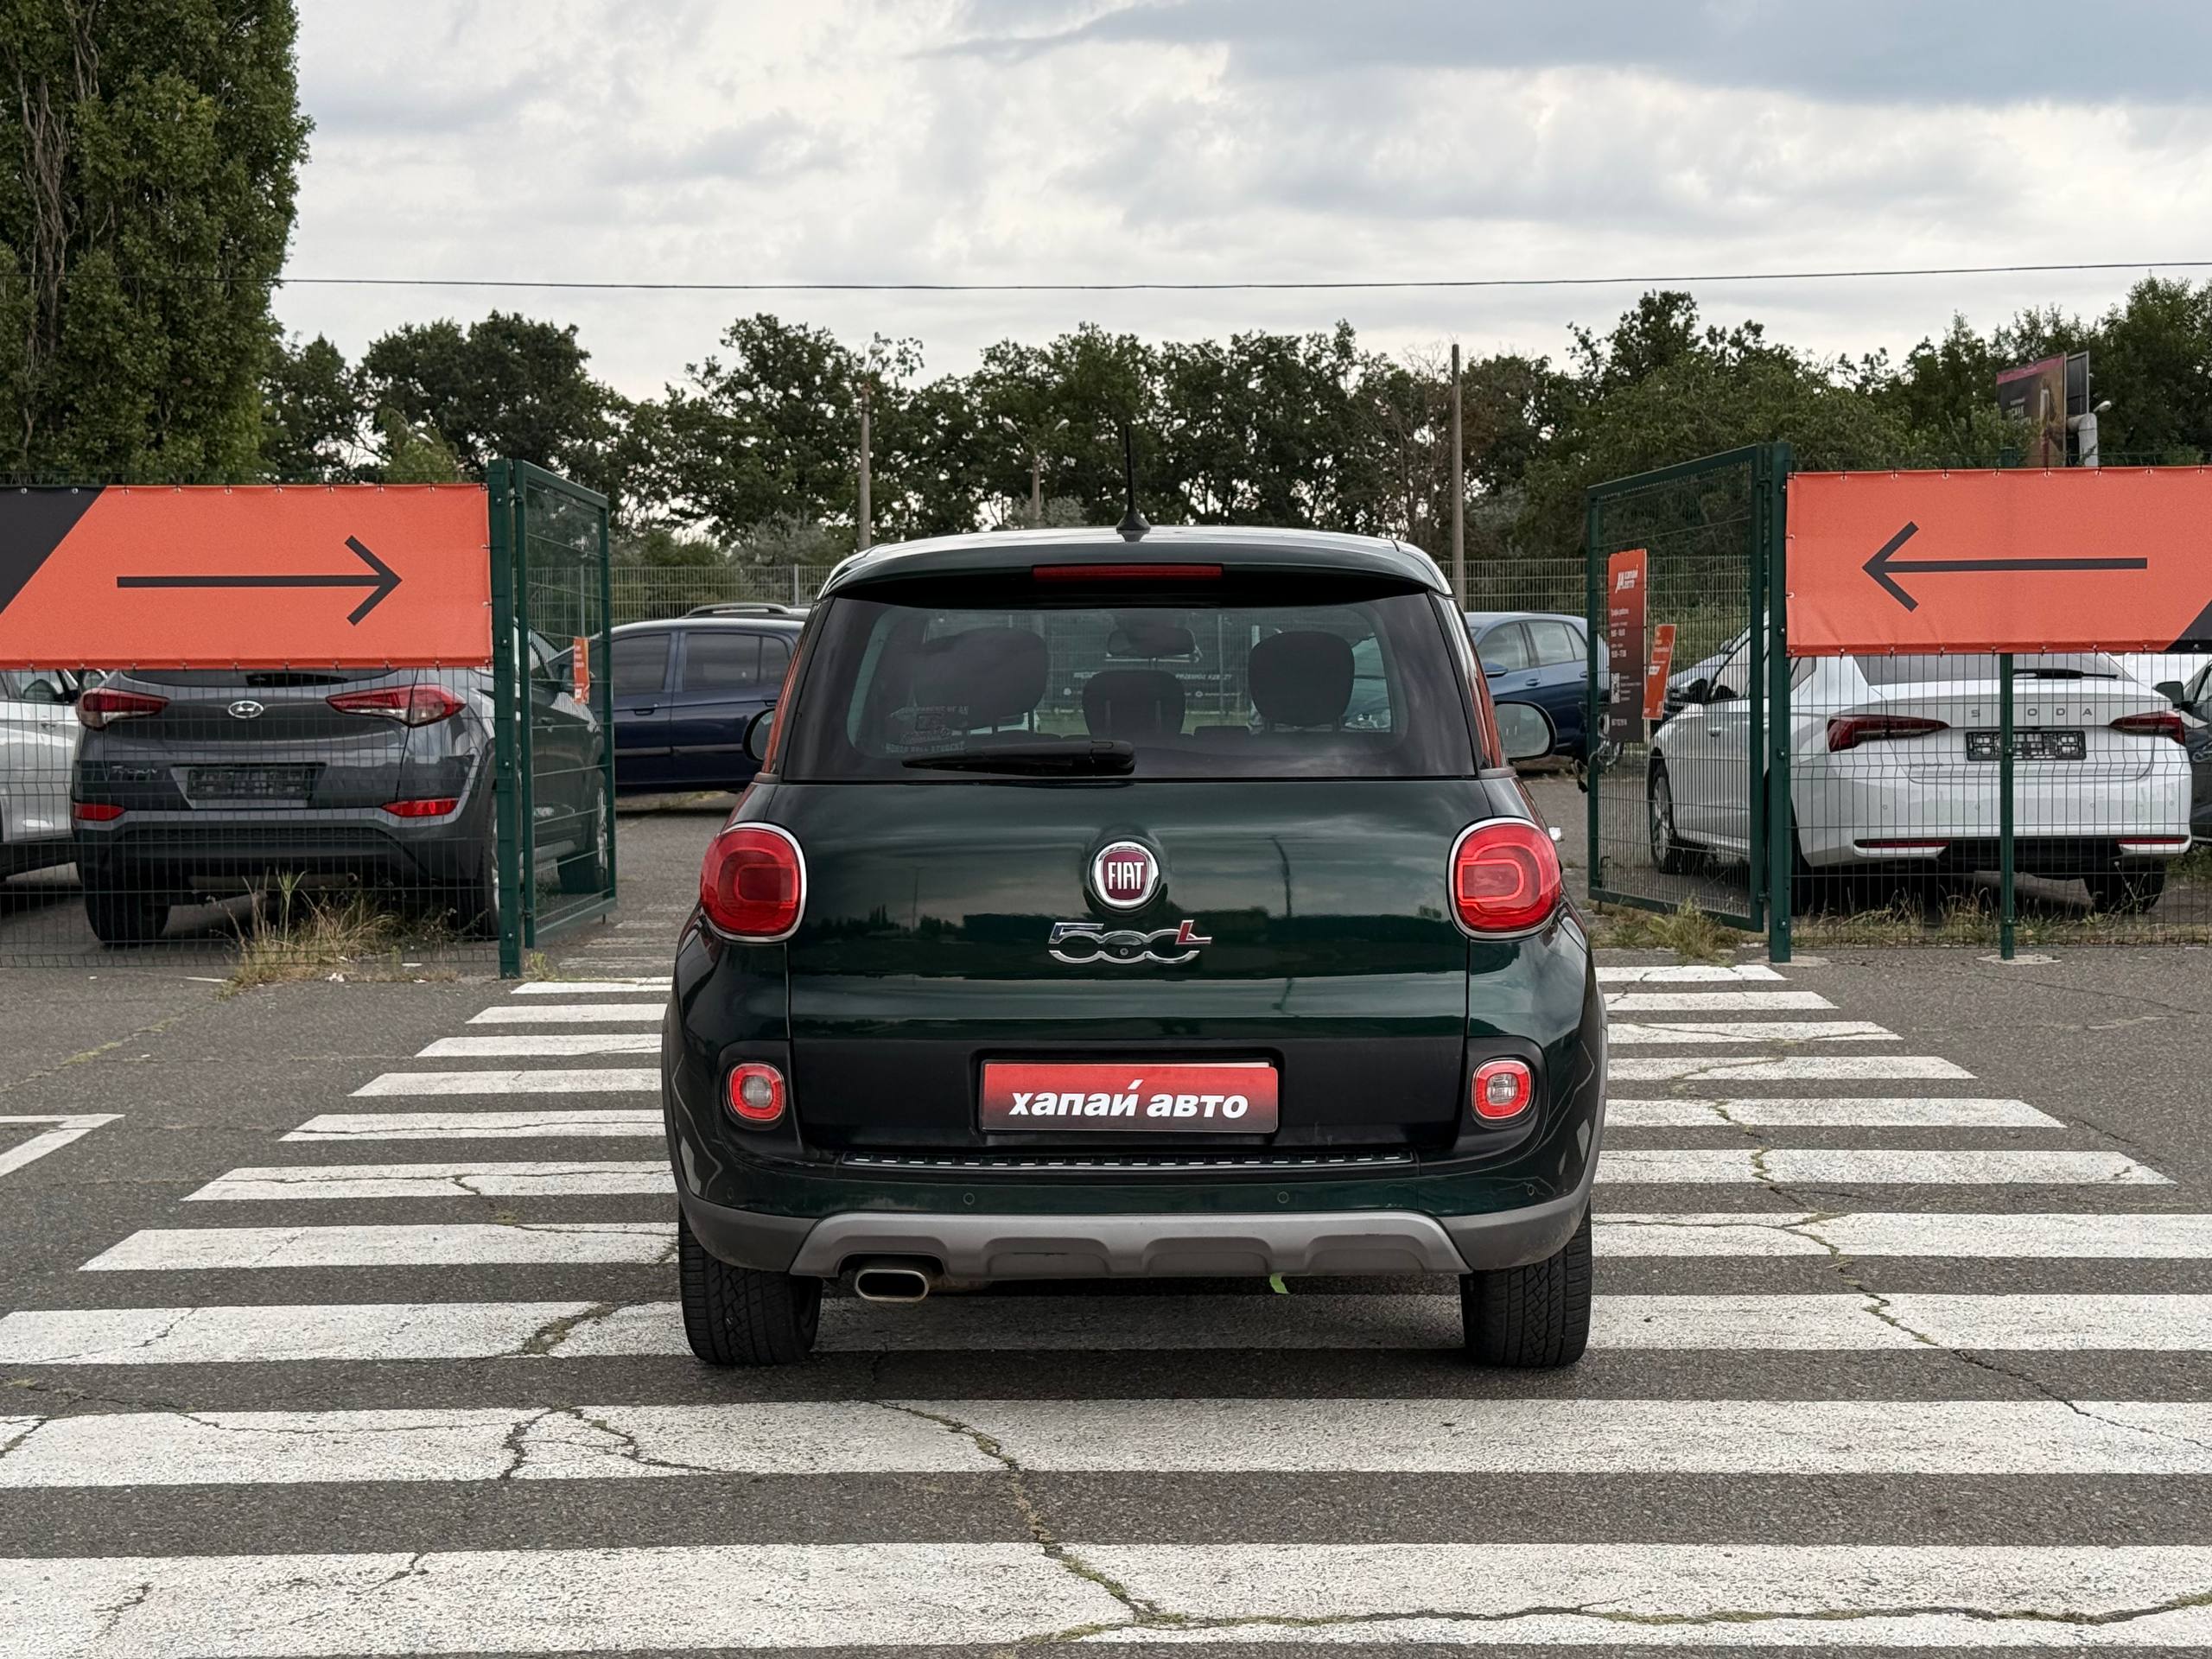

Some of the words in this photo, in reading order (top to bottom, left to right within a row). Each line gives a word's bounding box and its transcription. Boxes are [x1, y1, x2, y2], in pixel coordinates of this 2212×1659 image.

[1970, 707, 2093, 718] SODA
[1107, 861, 1145, 890] FIAT
[1047, 918, 1213, 964] 500L
[1008, 1078, 1145, 1117] хапай
[1146, 1093, 1249, 1119] авто
